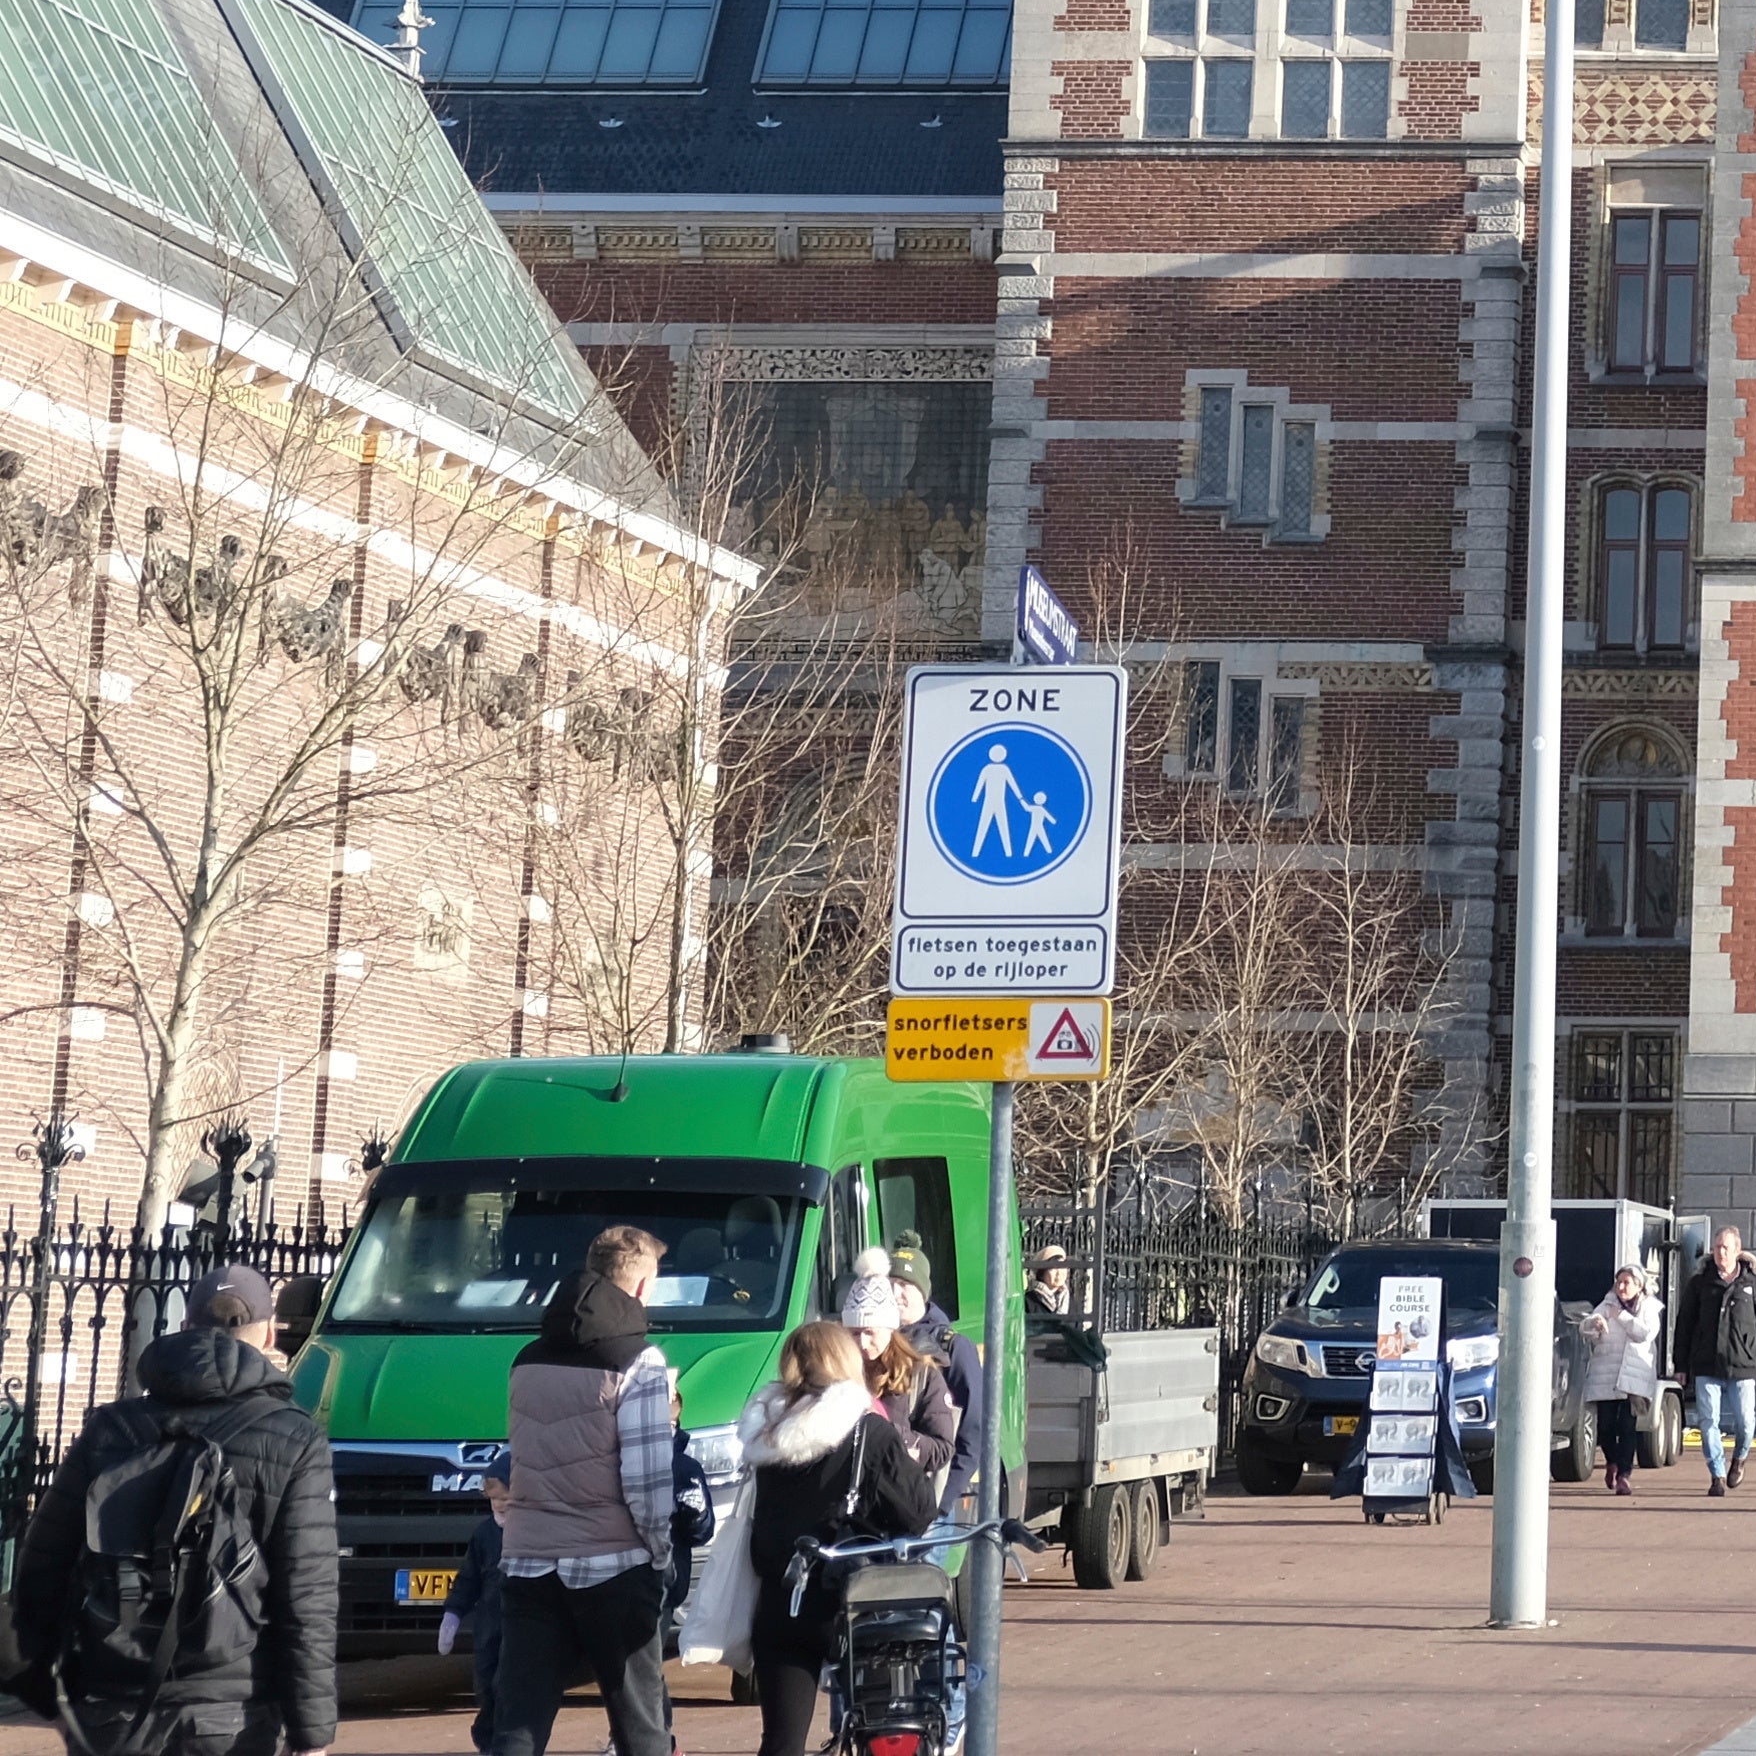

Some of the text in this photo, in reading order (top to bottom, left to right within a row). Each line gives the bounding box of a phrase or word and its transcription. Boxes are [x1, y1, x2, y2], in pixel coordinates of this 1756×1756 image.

[970, 689, 1061, 712] ZONE
[908, 936, 1097, 958] fietsen toegestaan
[934, 960, 1068, 983] op de rijloper
[894, 1013, 1027, 1033] snorfietsers
[894, 1043, 994, 1062] verboden
[1398, 1285, 1424, 1293] FREE
[1389, 1304, 1431, 1312] COURSE
[1395, 1295, 1426, 1303] BIBLE
[432, 1473, 485, 1492] MA
